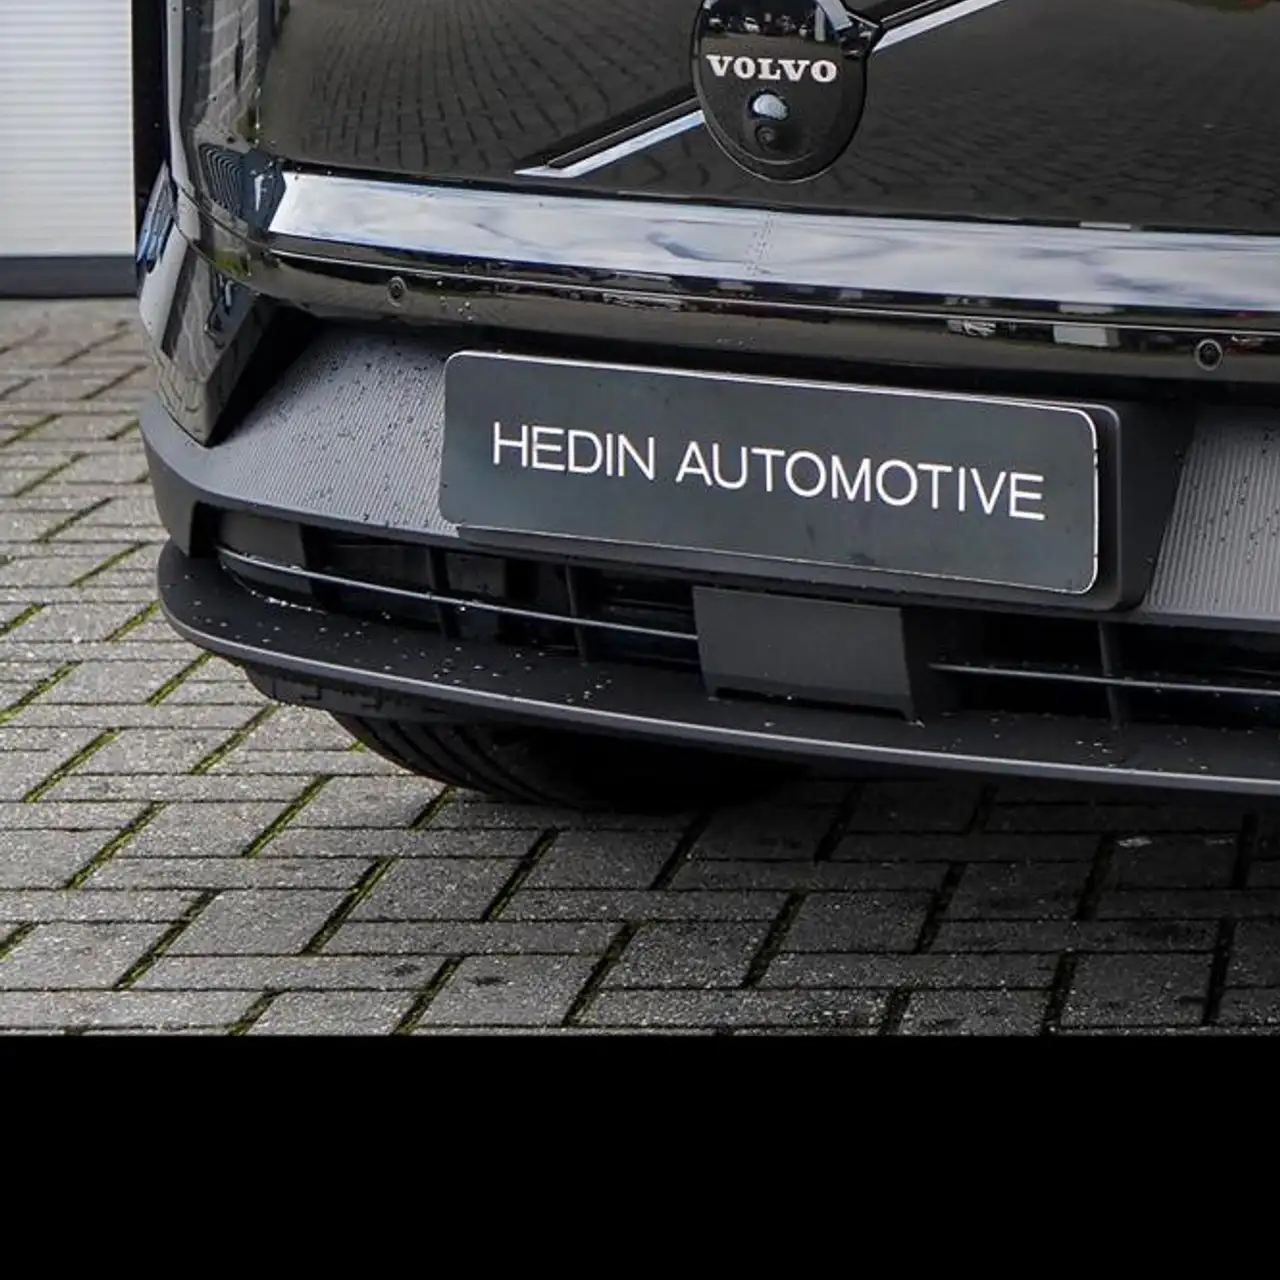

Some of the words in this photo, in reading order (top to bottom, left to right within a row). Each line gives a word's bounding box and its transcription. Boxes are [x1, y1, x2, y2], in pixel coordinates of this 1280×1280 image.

[706, 54, 837, 82] VOLVO
[493, 421, 656, 481] HEDIN
[675, 441, 1045, 521] AUTOMOTIVE
